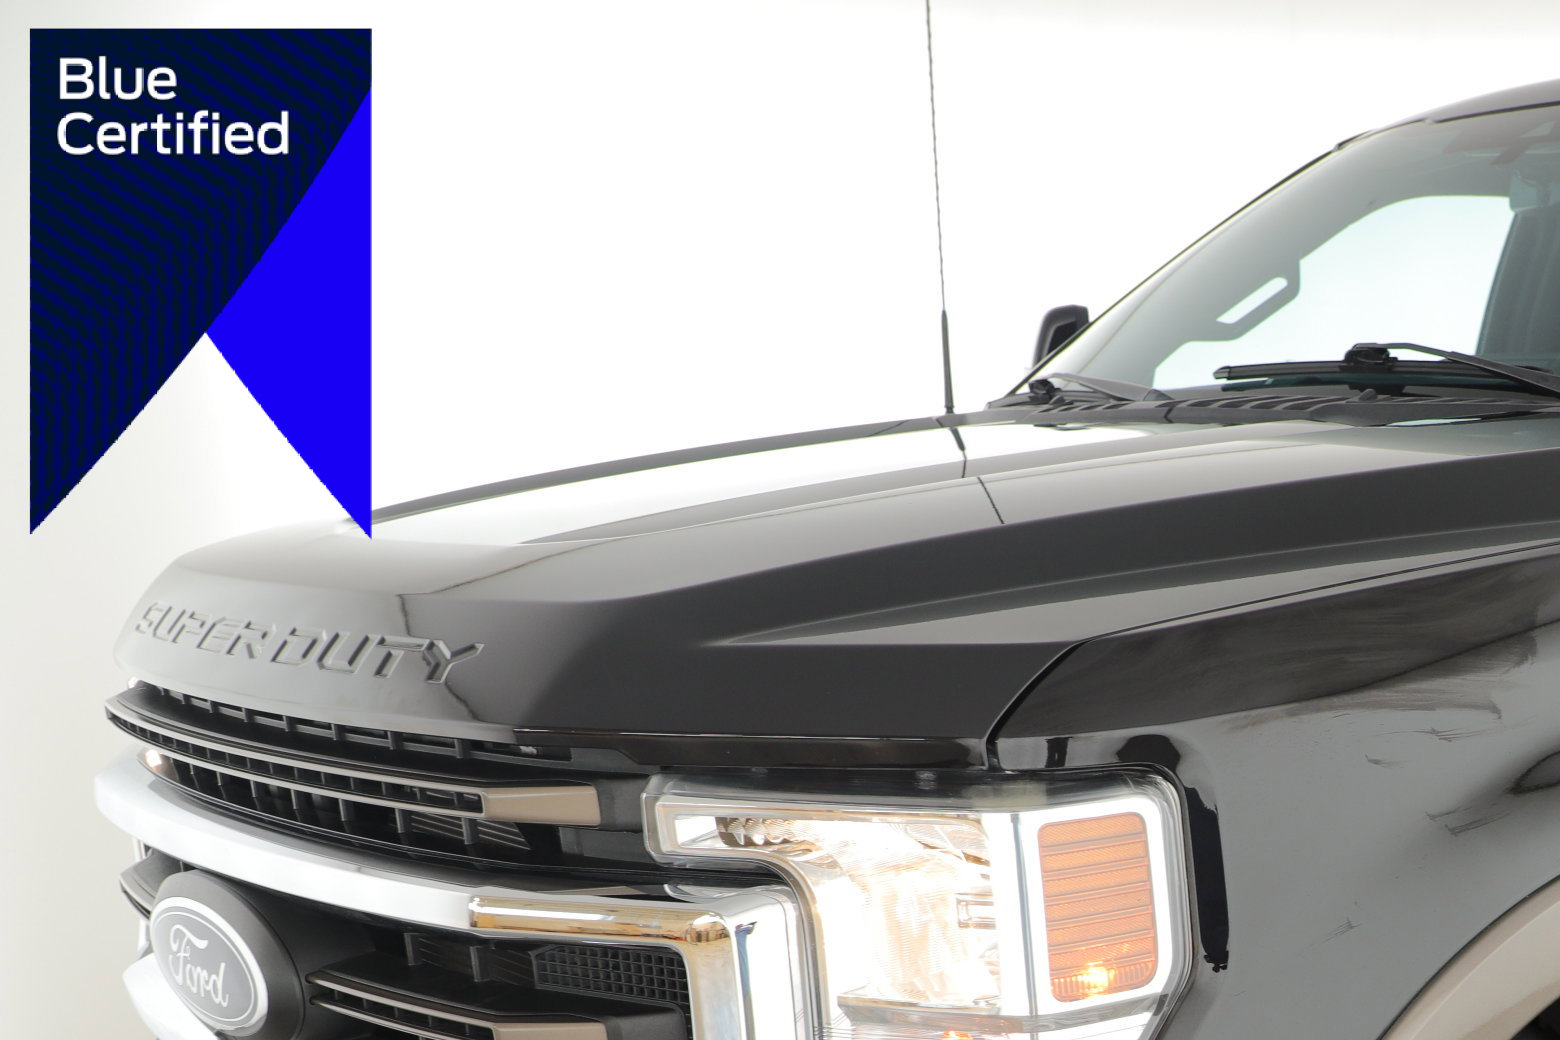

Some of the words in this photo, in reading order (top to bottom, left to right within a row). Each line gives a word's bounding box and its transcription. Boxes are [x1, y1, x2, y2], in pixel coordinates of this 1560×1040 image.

[134, 601, 277, 660] SUPER
[271, 626, 485, 684] DUTY
[168, 924, 230, 1008] Ford
